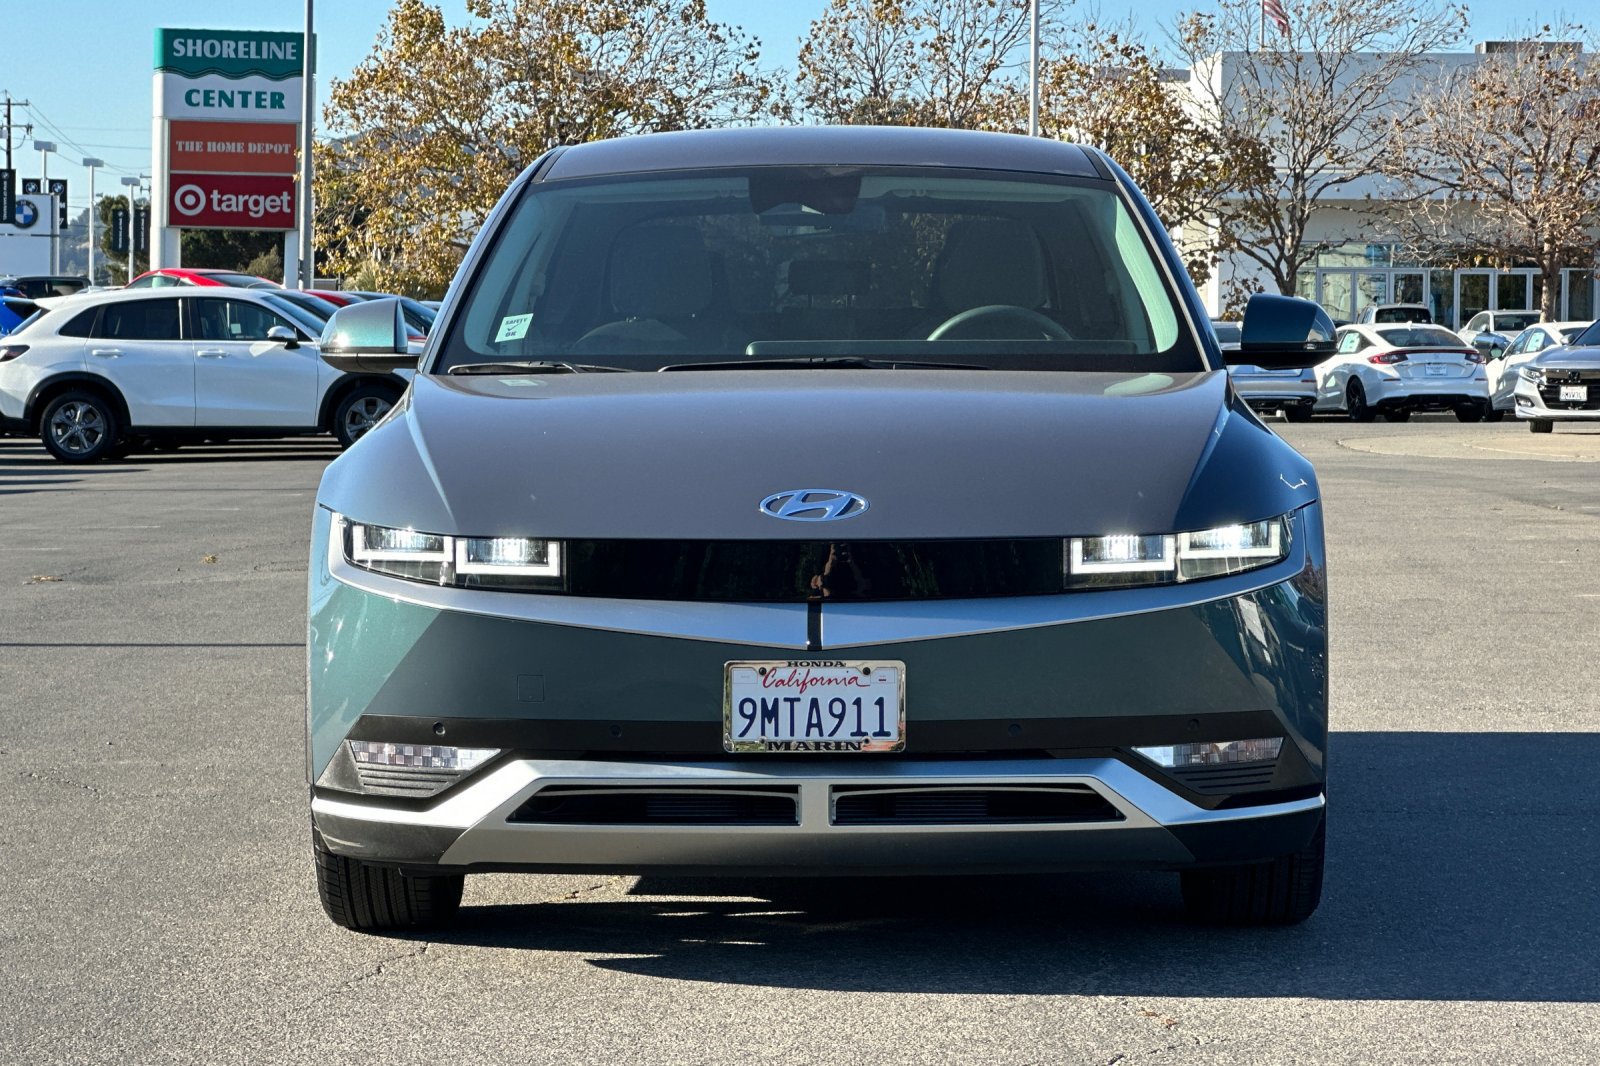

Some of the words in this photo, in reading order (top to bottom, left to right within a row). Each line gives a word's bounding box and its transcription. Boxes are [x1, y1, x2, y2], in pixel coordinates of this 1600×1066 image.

[173, 38, 297, 60] SHORELINE
[184, 88, 286, 110] CENTER
[176, 140, 203, 153] THE
[207, 141, 245, 154] HOME
[248, 142, 291, 154] DEPOT
[210, 189, 291, 218] target
[505, 317, 528, 325] SAFETY
[787, 660, 847, 668] HONDA
[762, 667, 871, 694] California
[738, 696, 892, 738] 9MTA911
[767, 741, 862, 751] MARIN
